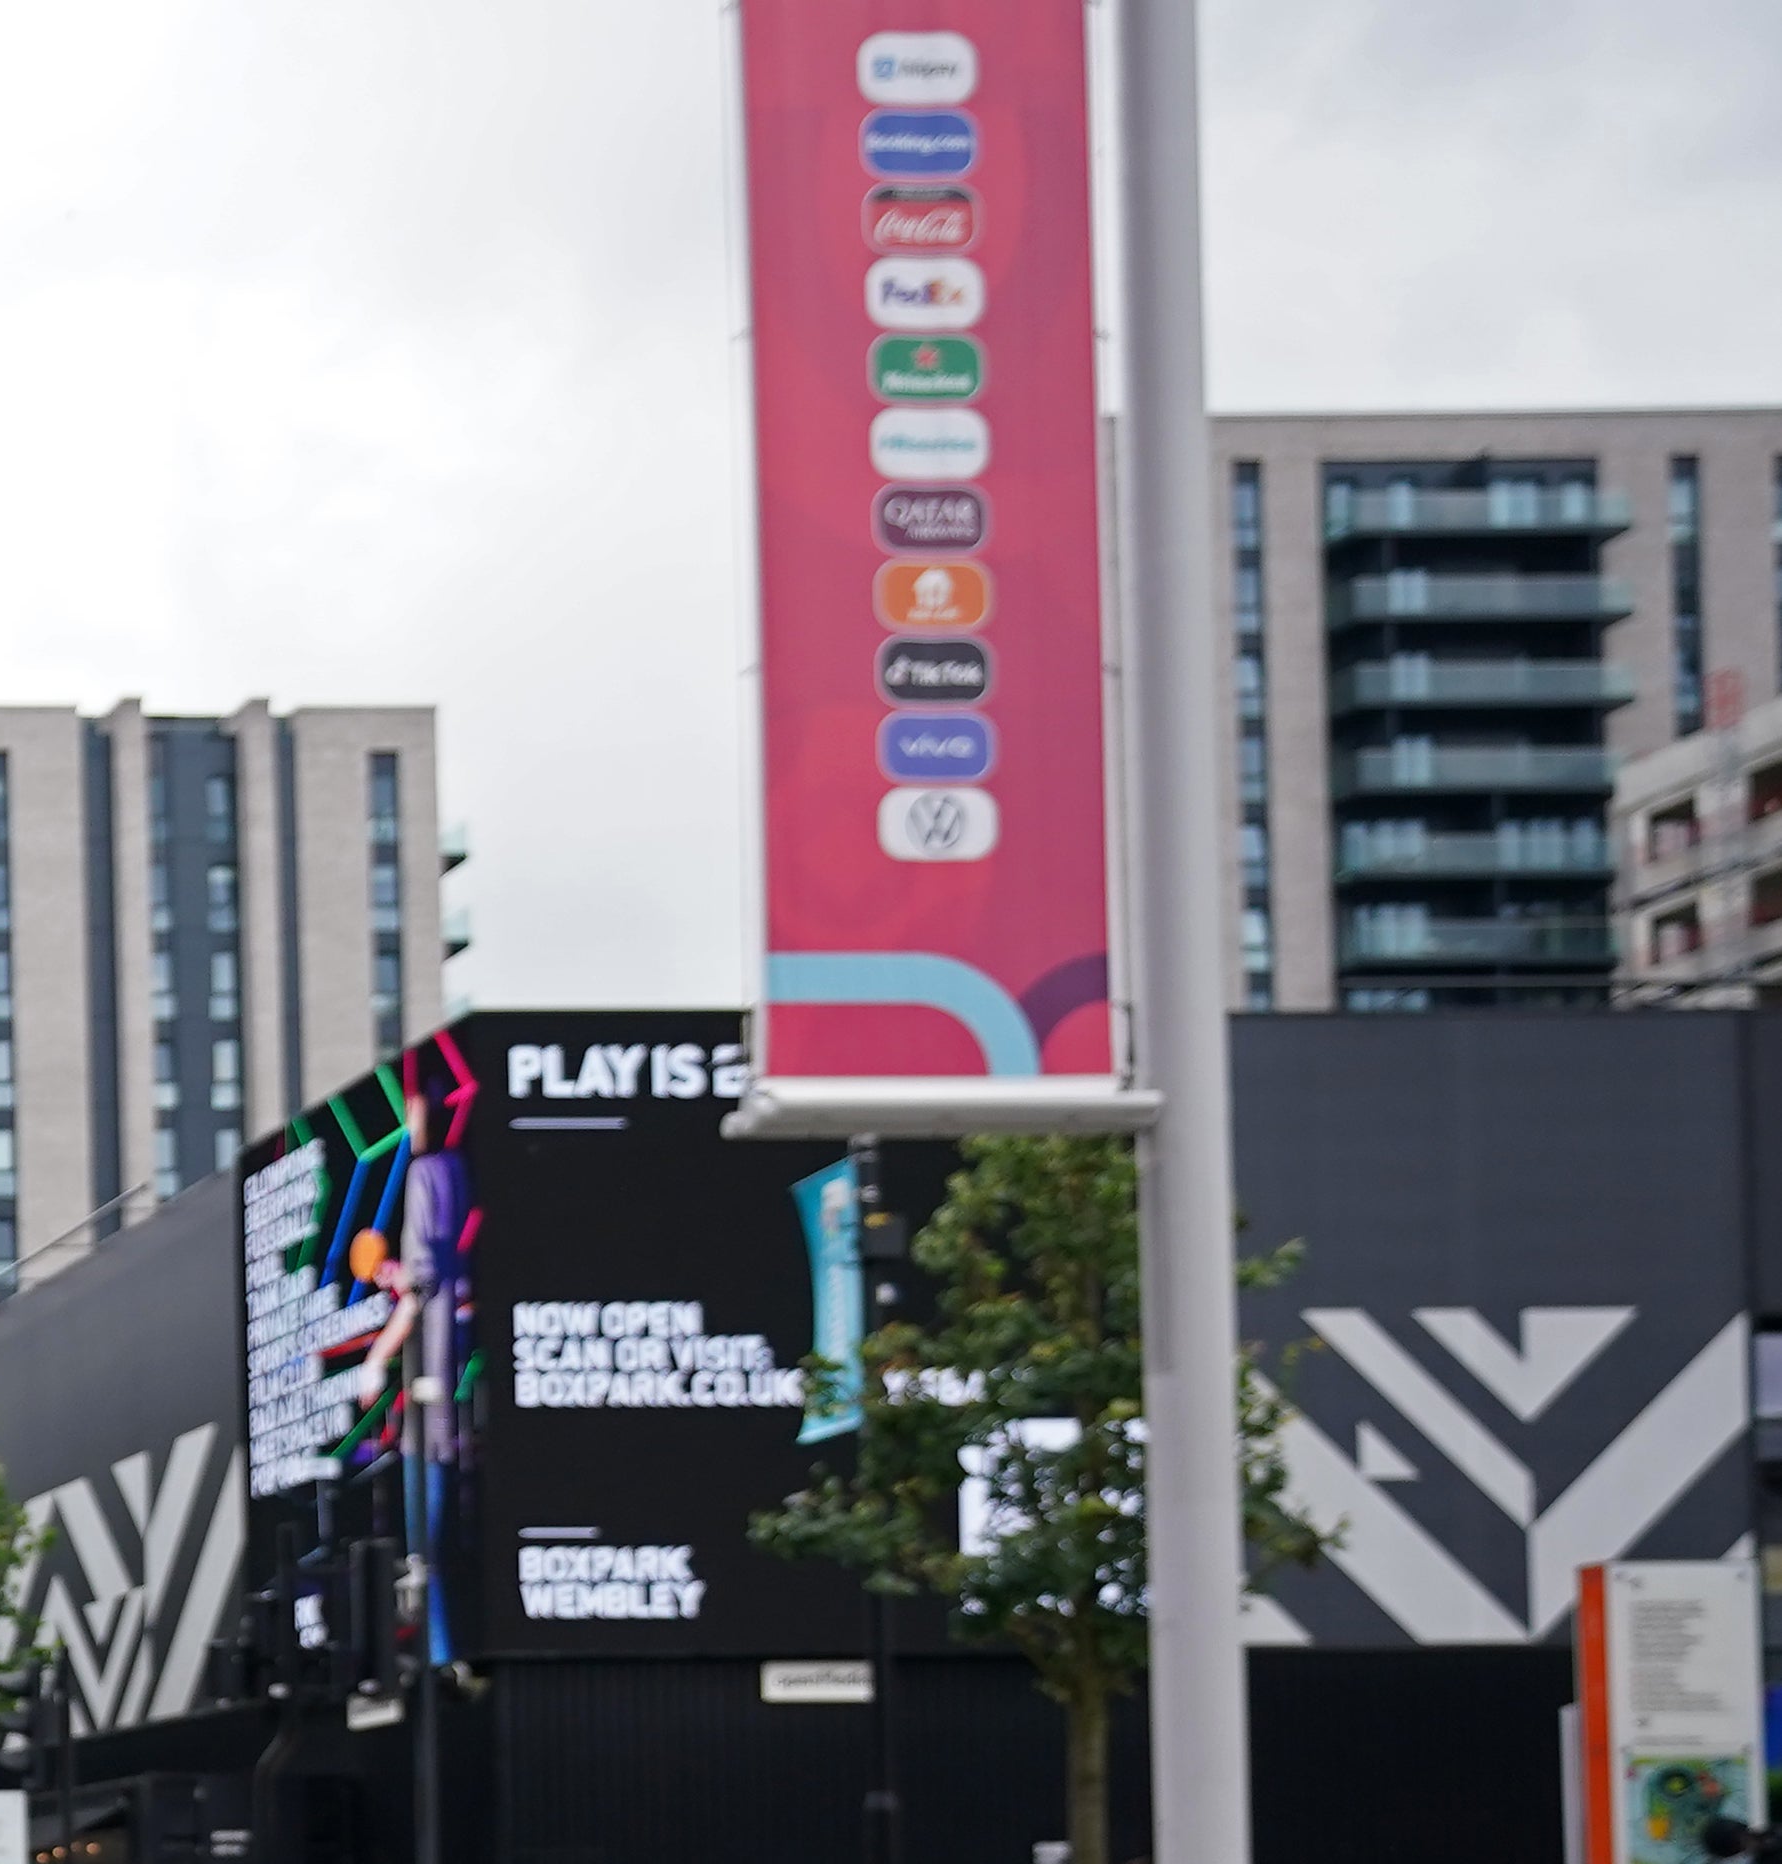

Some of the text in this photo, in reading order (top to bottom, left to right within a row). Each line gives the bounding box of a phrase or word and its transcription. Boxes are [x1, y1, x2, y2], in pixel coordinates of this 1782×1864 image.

[884, 497, 976, 528] QATAR
[507, 1043, 648, 1099] PLAY
[650, 1043, 709, 1099] IS
[513, 1301, 704, 1339] NOW OPEN
[512, 1336, 614, 1372] SCAN
[614, 1336, 674, 1373] OR
[514, 1368, 806, 1408] BOXPARK.CO.UK
[518, 1545, 695, 1582] BOXPARK
[519, 1580, 708, 1620] WEMBLEY
